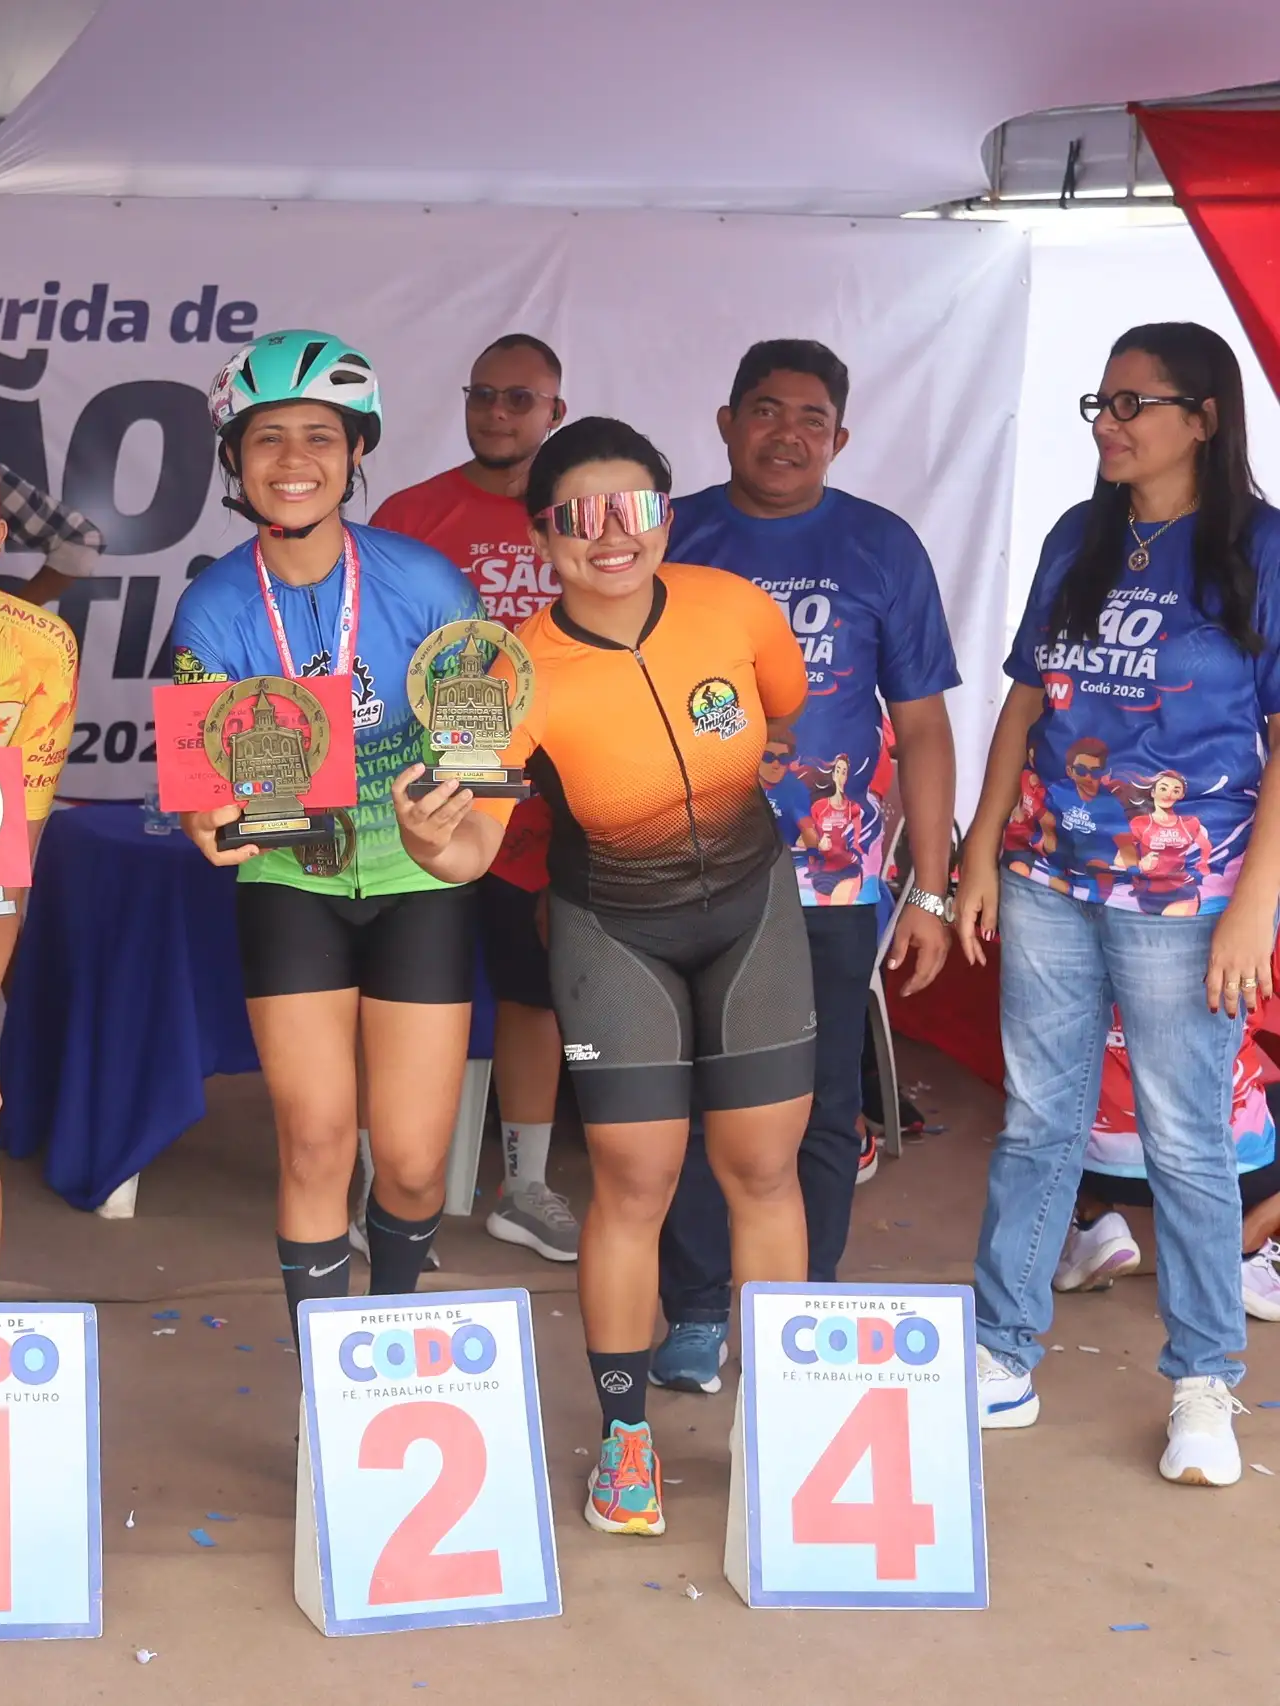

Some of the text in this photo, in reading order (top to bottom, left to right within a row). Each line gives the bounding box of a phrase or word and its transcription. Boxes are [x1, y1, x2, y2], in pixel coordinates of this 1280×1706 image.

[168, 284, 258, 344] de
[819, 578, 840, 592] de
[1159, 590, 1179, 605] de
[0, 604, 76, 672] ANASTASIA
[1080, 680, 1111, 694] Codó
[1112, 684, 1146, 699] 2026
[805, 1301, 906, 1310] PREFEITURA DE
[8, 1318, 24, 1327] DE
[361, 1310, 462, 1324] PREFEITURA DE
[781, 1310, 940, 1366] CODÓ
[339, 1318, 497, 1382] CODÓ
[807, 1372, 872, 1381] TRABALHO
[878, 1373, 884, 1381] E
[890, 1373, 940, 1382] FUTURO
[6, 1392, 60, 1402] FUTURO
[366, 1385, 432, 1399] TRABALHO
[438, 1384, 444, 1393] E
[449, 1381, 499, 1392] FUTURO
[791, 1387, 936, 1581] 4
[357, 1400, 503, 1605] 2
